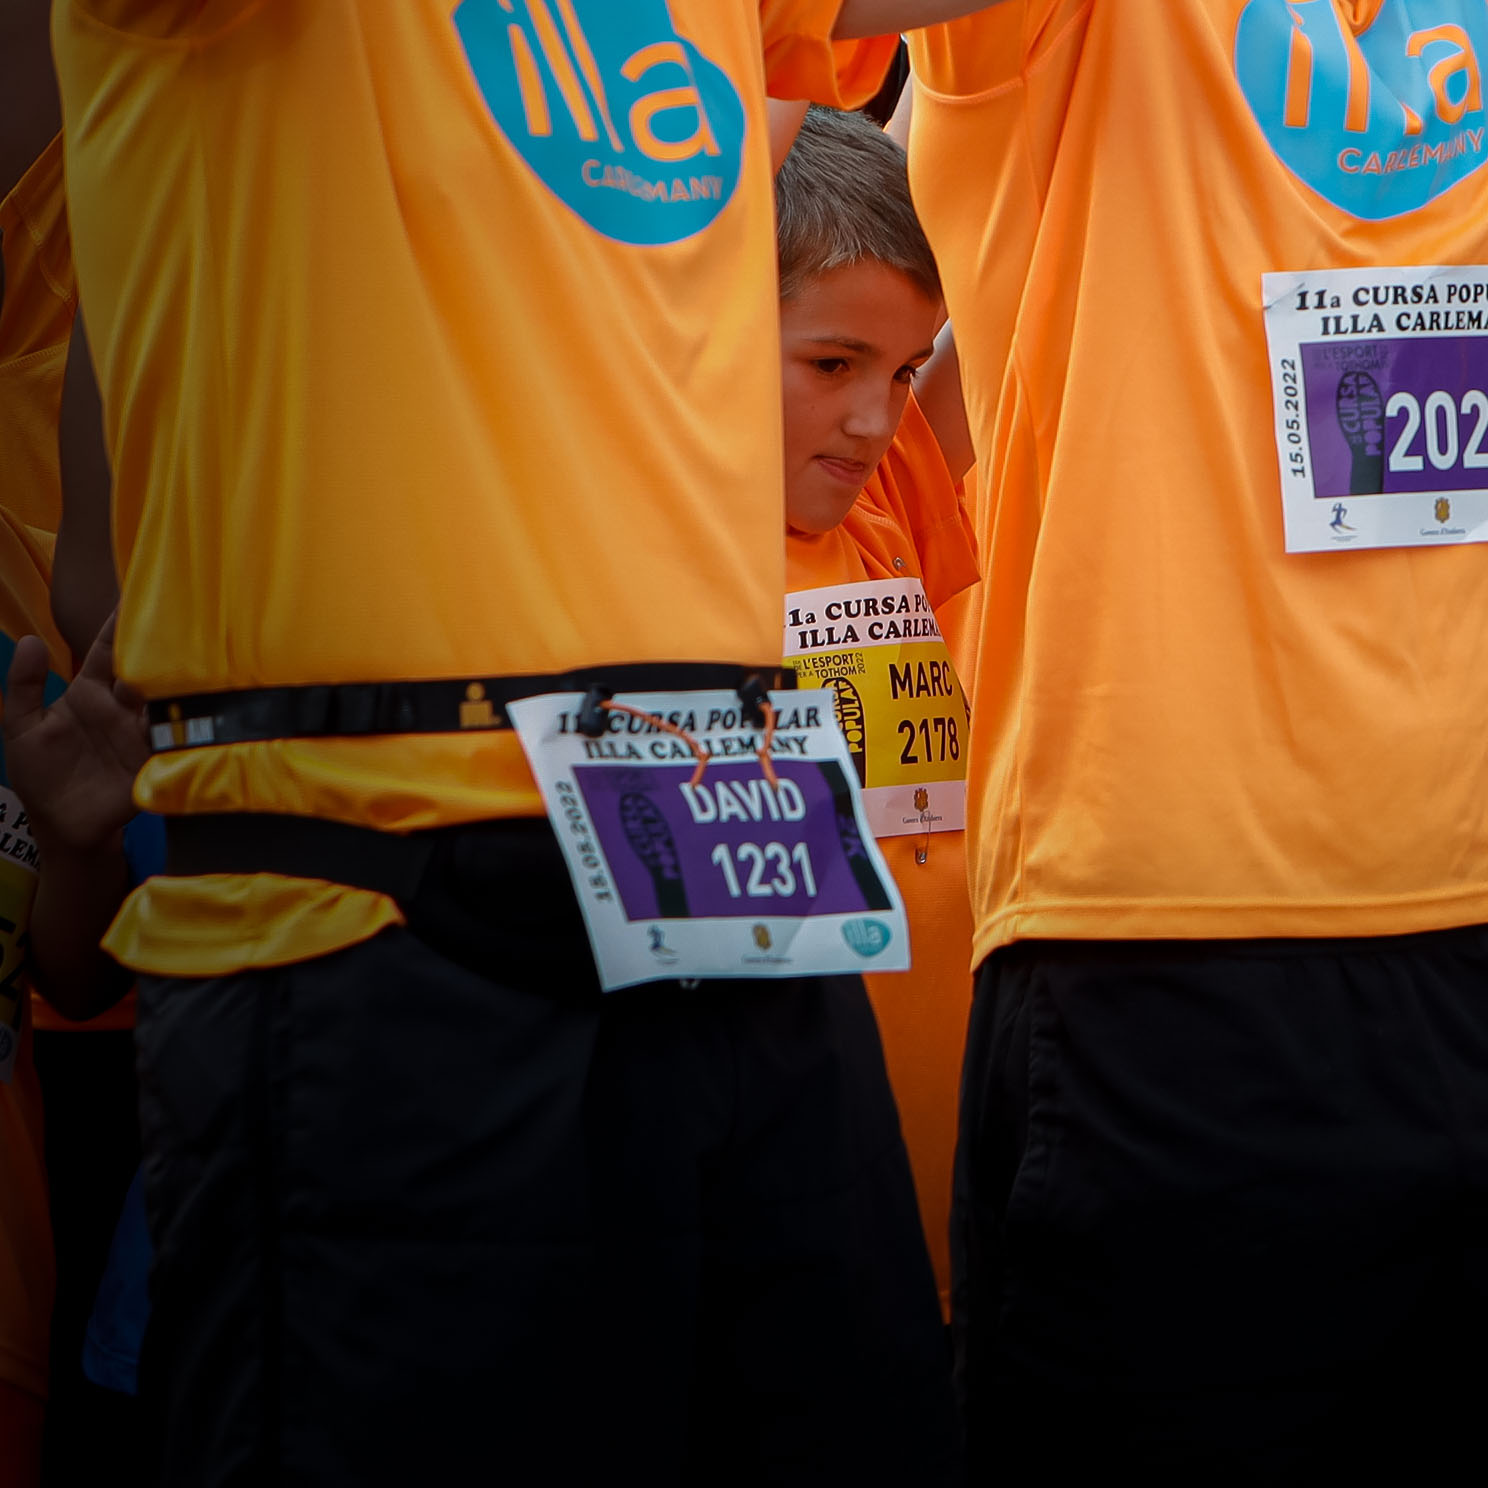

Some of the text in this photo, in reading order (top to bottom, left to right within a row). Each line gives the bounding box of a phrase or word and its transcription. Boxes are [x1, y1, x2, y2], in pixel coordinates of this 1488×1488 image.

[1338, 128, 1484, 174] CARLEMANY
[582, 159, 722, 202] CARMANY
[1296, 289, 1342, 311] 11a
[1352, 284, 1440, 307] CURSA
[1321, 312, 1386, 336] ILLA
[1281, 358, 1306, 479] 15.05.2022
[786, 607, 816, 627] 1a
[825, 594, 911, 619] CURSA
[798, 617, 943, 649] ILLA CARLEM
[803, 653, 854, 670] L'ESPORT
[815, 665, 858, 679] TOTHOM
[889, 661, 953, 700] MARC
[558, 712, 586, 734] 11
[705, 706, 822, 732] POPLAR
[583, 738, 643, 761] ILLA
[897, 716, 960, 764] 2178
[679, 777, 806, 824] DAVID
[711, 842, 818, 898] 1231
